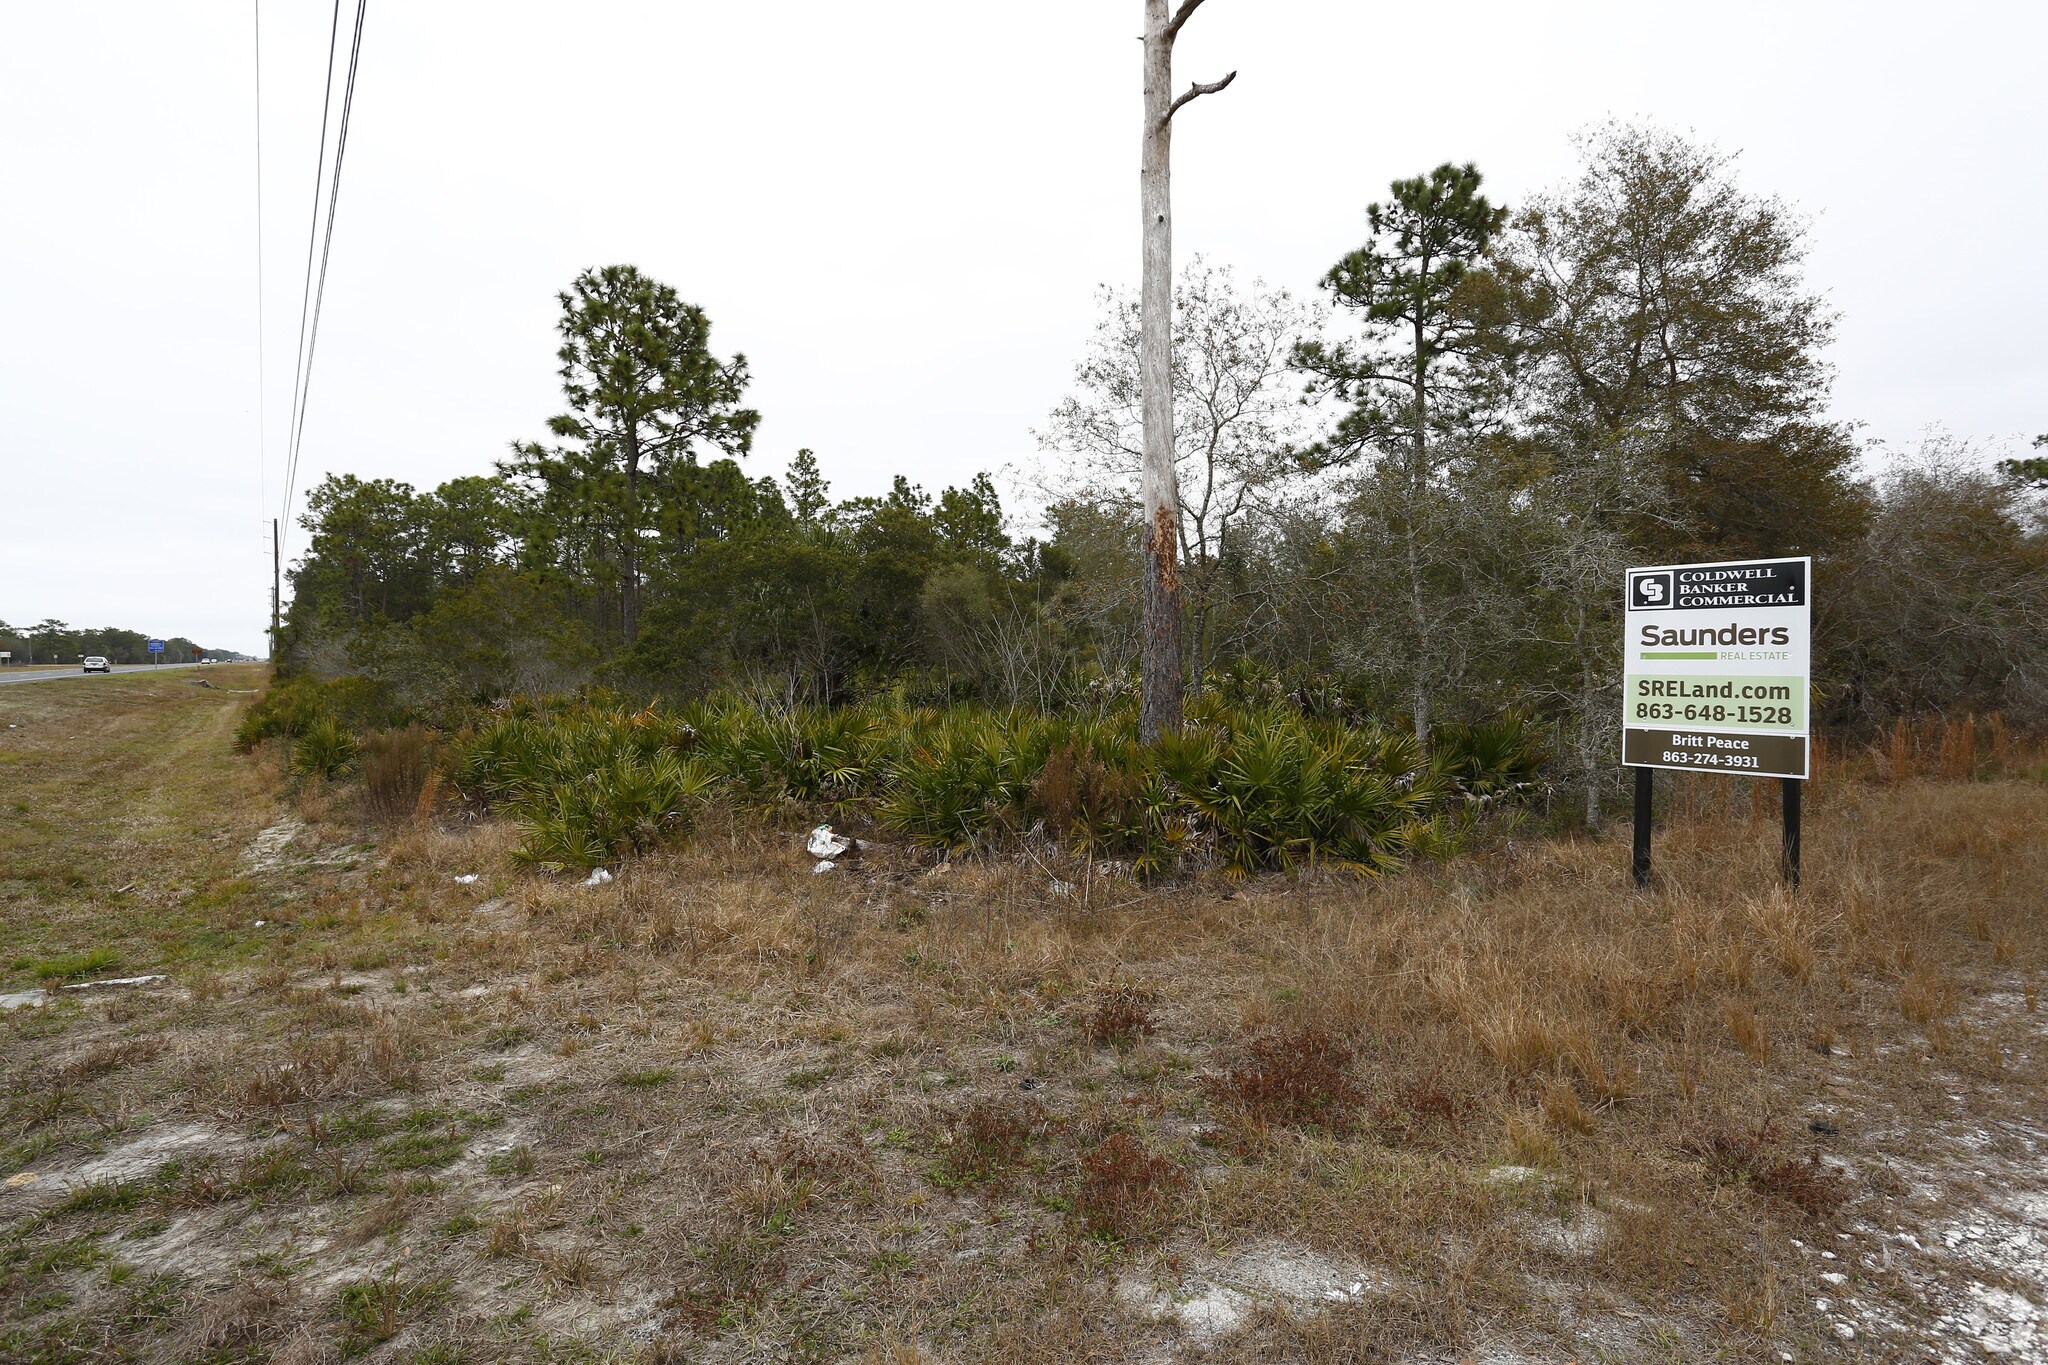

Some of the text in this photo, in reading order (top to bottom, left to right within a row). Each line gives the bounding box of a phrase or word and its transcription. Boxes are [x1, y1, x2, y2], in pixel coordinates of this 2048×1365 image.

[1679, 568, 1777, 582] COLDWELL
[1679, 583, 1749, 594] BANKER
[1679, 593, 1798, 607] COMMERCIAL
[1640, 623, 1789, 646] Saunders
[1721, 652, 1789, 660] REAL ESTATE
[1638, 680, 1790, 699] SRELand.com
[1636, 703, 1792, 724] 863-648-1528
[1672, 735, 1749, 749] Britt Peace
[1663, 751, 1759, 768] 863-274-3931
